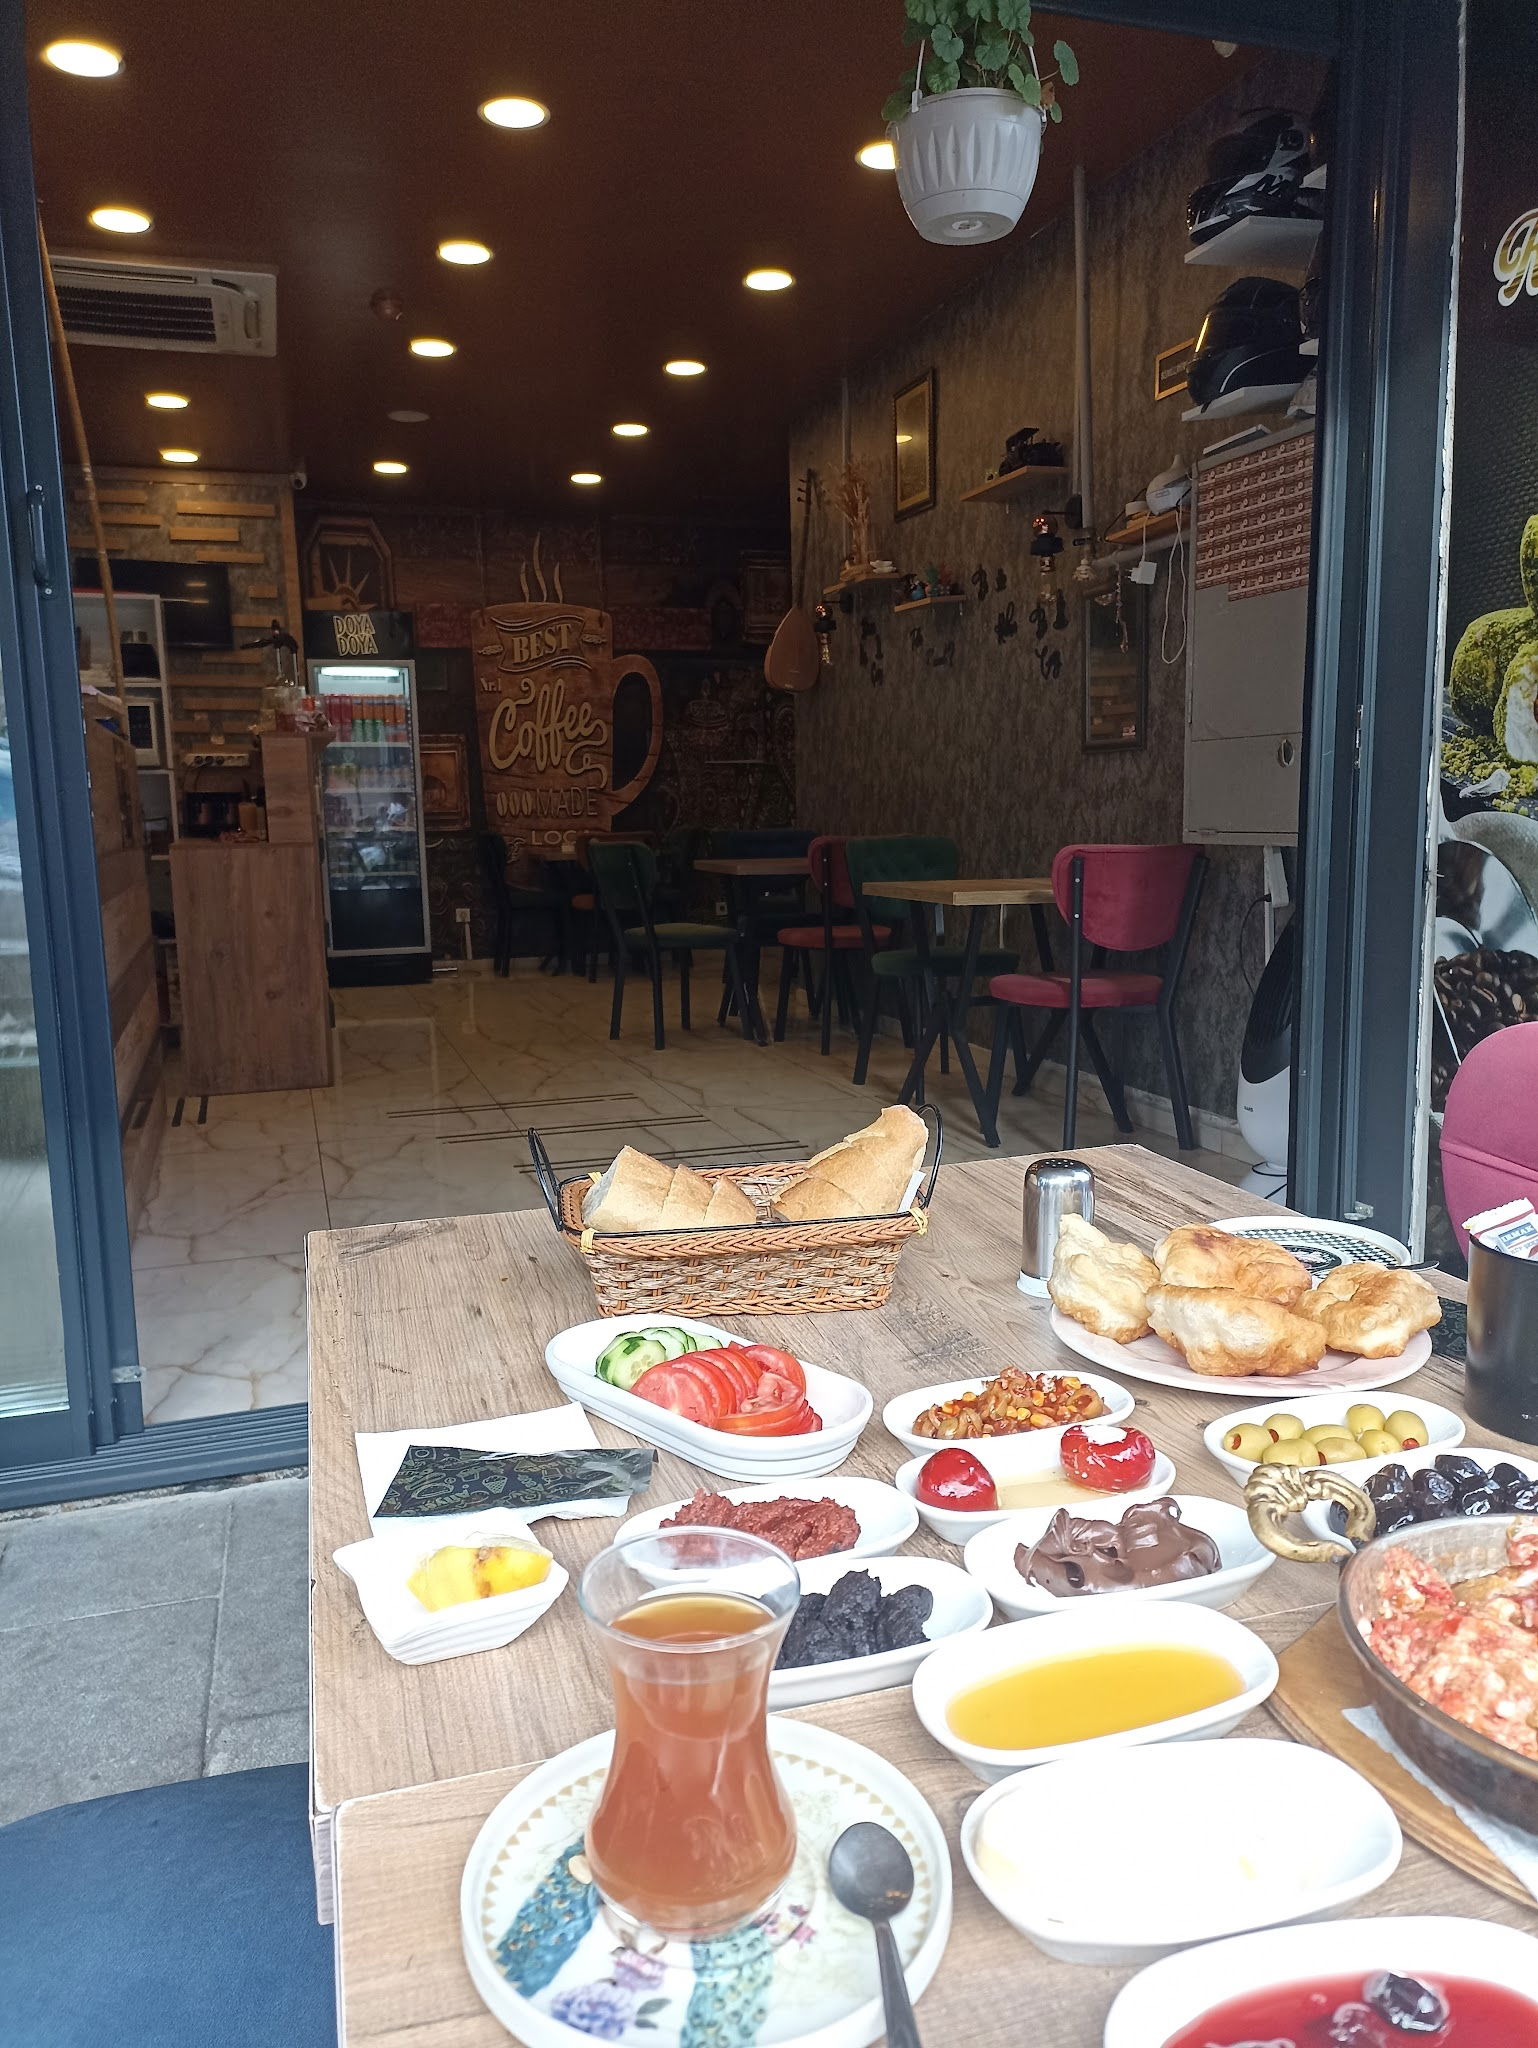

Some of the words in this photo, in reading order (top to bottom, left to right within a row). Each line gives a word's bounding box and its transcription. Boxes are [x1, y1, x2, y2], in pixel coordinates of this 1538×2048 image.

[333, 614, 376, 636] DOYA
[336, 634, 379, 656] DOYA
[511, 622, 573, 664] BEST
[489, 678, 607, 782] Coffee
[537, 786, 598, 817] MADE
[531, 830, 590, 847] LOC
